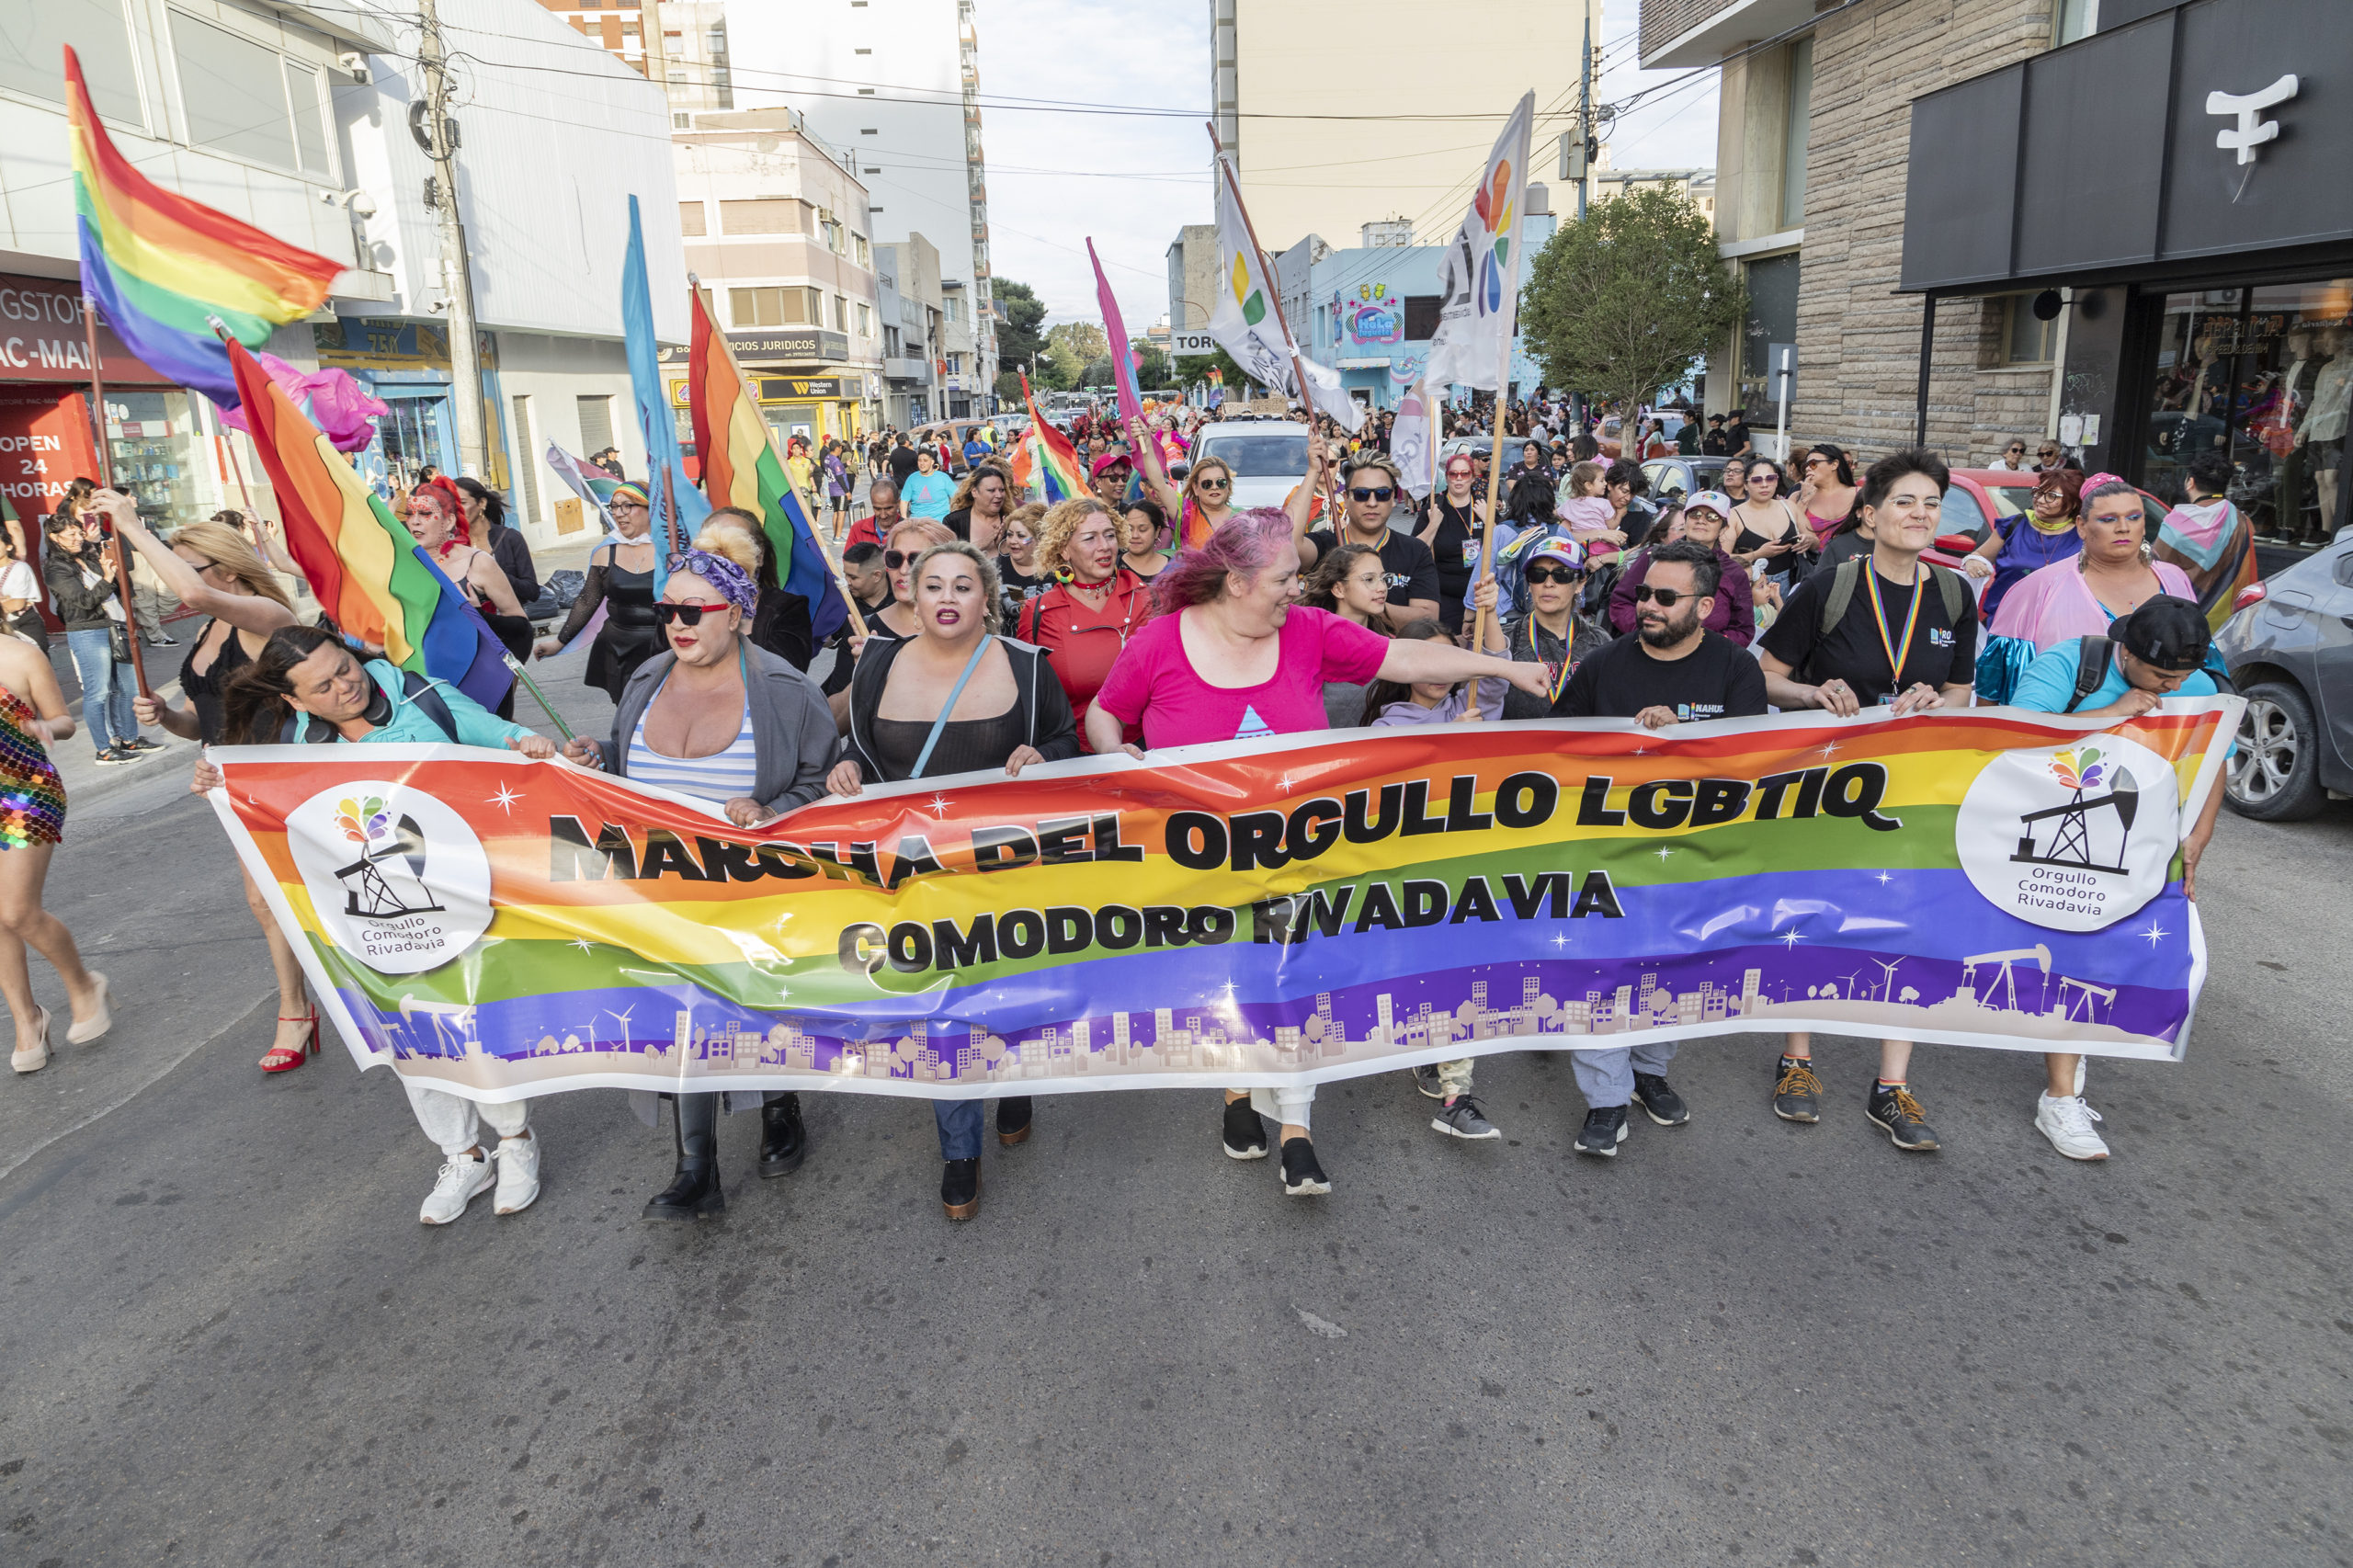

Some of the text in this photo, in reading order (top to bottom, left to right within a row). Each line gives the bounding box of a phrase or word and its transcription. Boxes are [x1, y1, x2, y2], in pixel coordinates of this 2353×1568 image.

[761, 340, 815, 350] JURIDICOS
[1176, 335, 1216, 348] TOR
[0, 435, 62, 452] OPEN
[20, 459, 49, 475] 24
[550, 761, 1904, 894] MARCHA DEL ORGULLO LGBTIQ
[2032, 868, 2097, 885] Orgullo
[2018, 880, 2106, 901] Comodoro
[2018, 893, 2101, 915] Rivadavia
[368, 917, 425, 931] Orgullo
[838, 869, 1625, 974] COMODORO RIVADAVIA
[364, 926, 441, 942] Comodoro
[367, 938, 445, 956] Rivadavia
